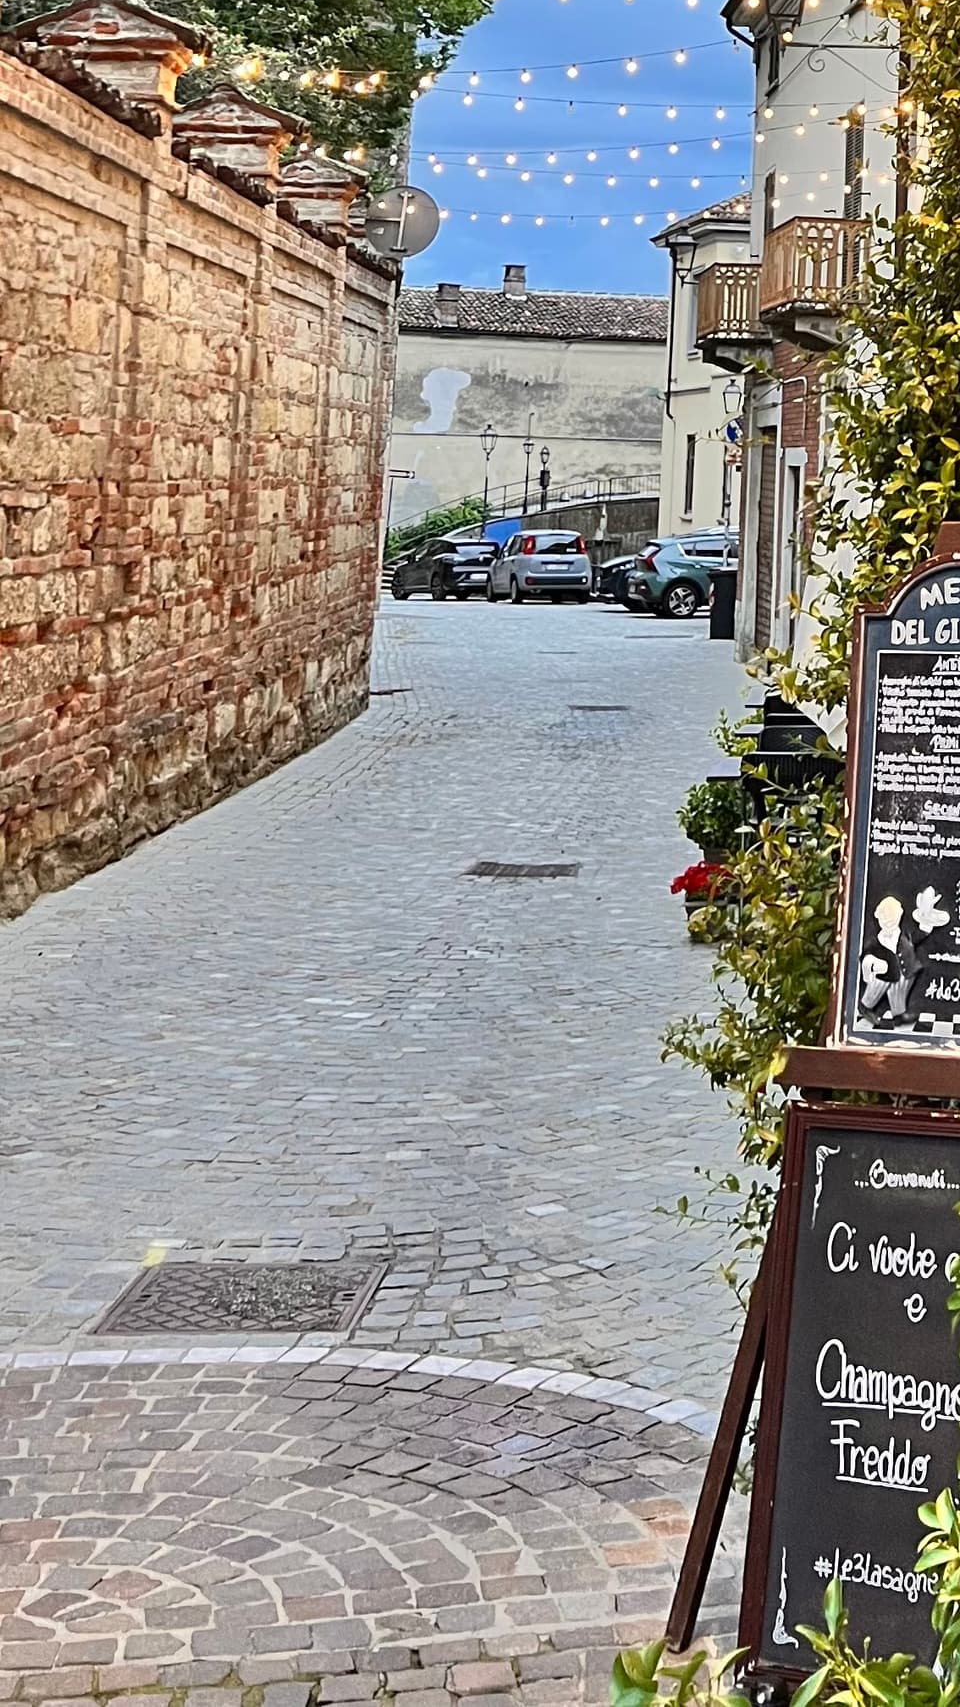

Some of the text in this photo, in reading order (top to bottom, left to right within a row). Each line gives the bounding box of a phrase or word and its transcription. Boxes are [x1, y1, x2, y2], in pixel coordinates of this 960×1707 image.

[891, 619, 930, 645] DEL
[827, 1222, 859, 1273] Ci
[869, 1233, 937, 1279] vuole
[904, 1293, 926, 1322] e
[830, 1419, 931, 1487] Freddo
